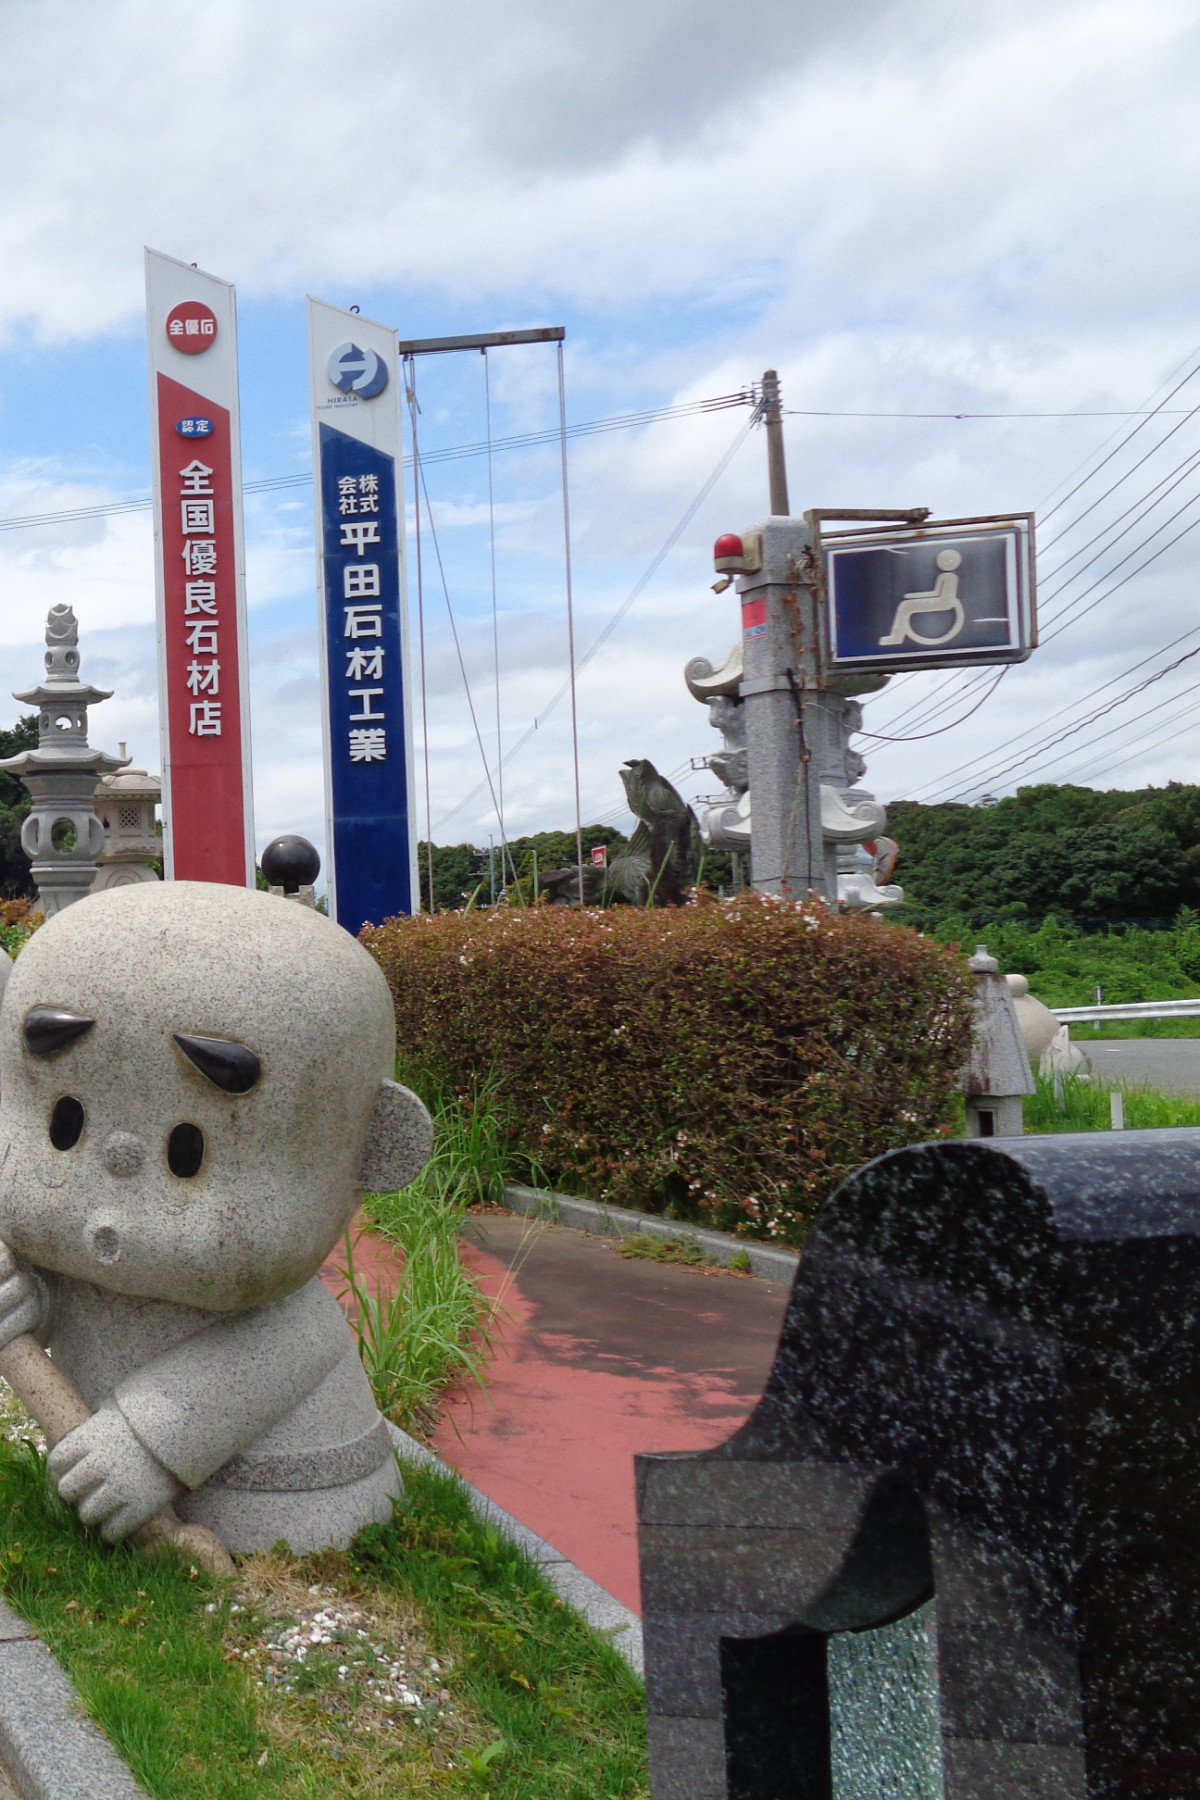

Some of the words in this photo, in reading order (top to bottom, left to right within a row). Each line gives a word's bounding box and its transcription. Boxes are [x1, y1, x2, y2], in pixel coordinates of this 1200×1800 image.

[169, 319, 214, 335] 全優石
[181, 420, 210, 433] 認定
[179, 459, 222, 736] 全国優良石材店
[340, 520, 387, 762] 平田石材工業
